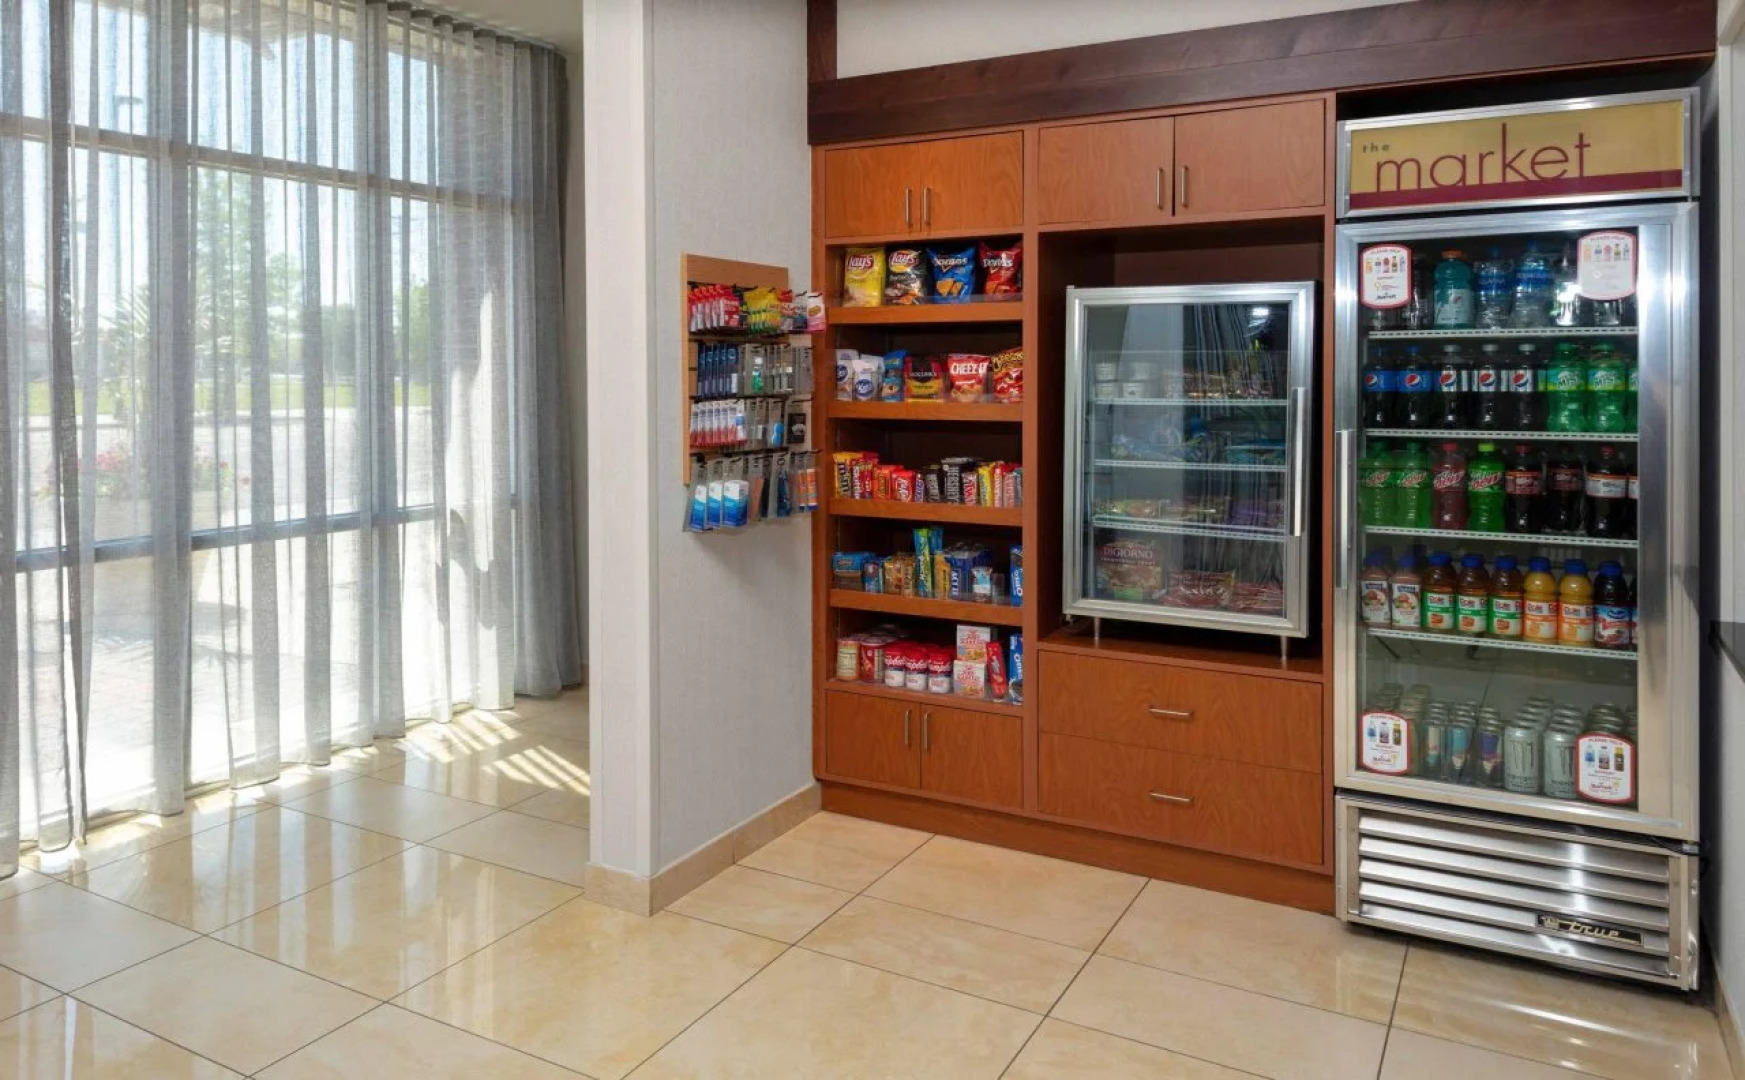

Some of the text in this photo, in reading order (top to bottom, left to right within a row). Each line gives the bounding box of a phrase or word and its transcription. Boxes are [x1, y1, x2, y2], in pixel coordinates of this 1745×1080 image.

[1362, 142, 1391, 154] the
[1375, 123, 1591, 194] market
[1568, 921, 1620, 939] true
